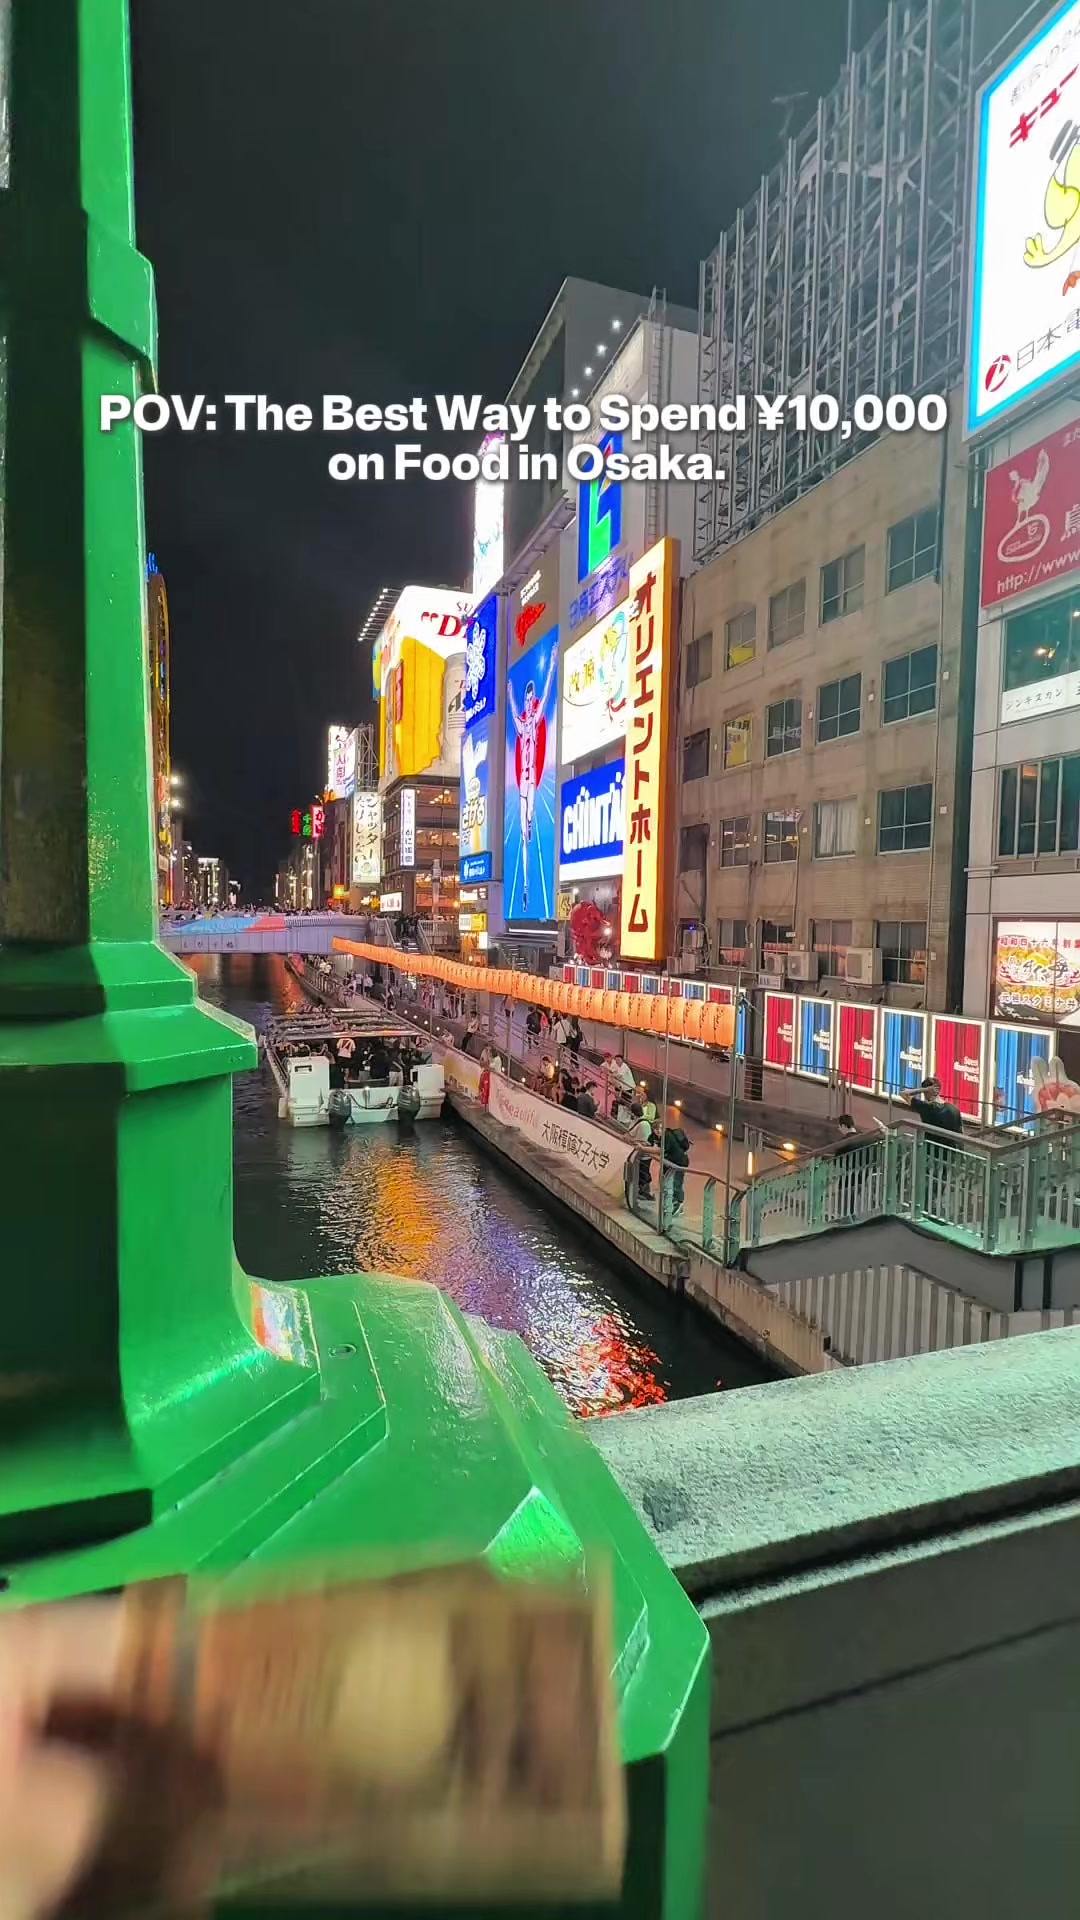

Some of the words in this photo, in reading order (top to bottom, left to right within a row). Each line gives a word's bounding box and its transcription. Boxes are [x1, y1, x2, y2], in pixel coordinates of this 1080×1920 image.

[629, 570, 657, 934] オリエントホーム
